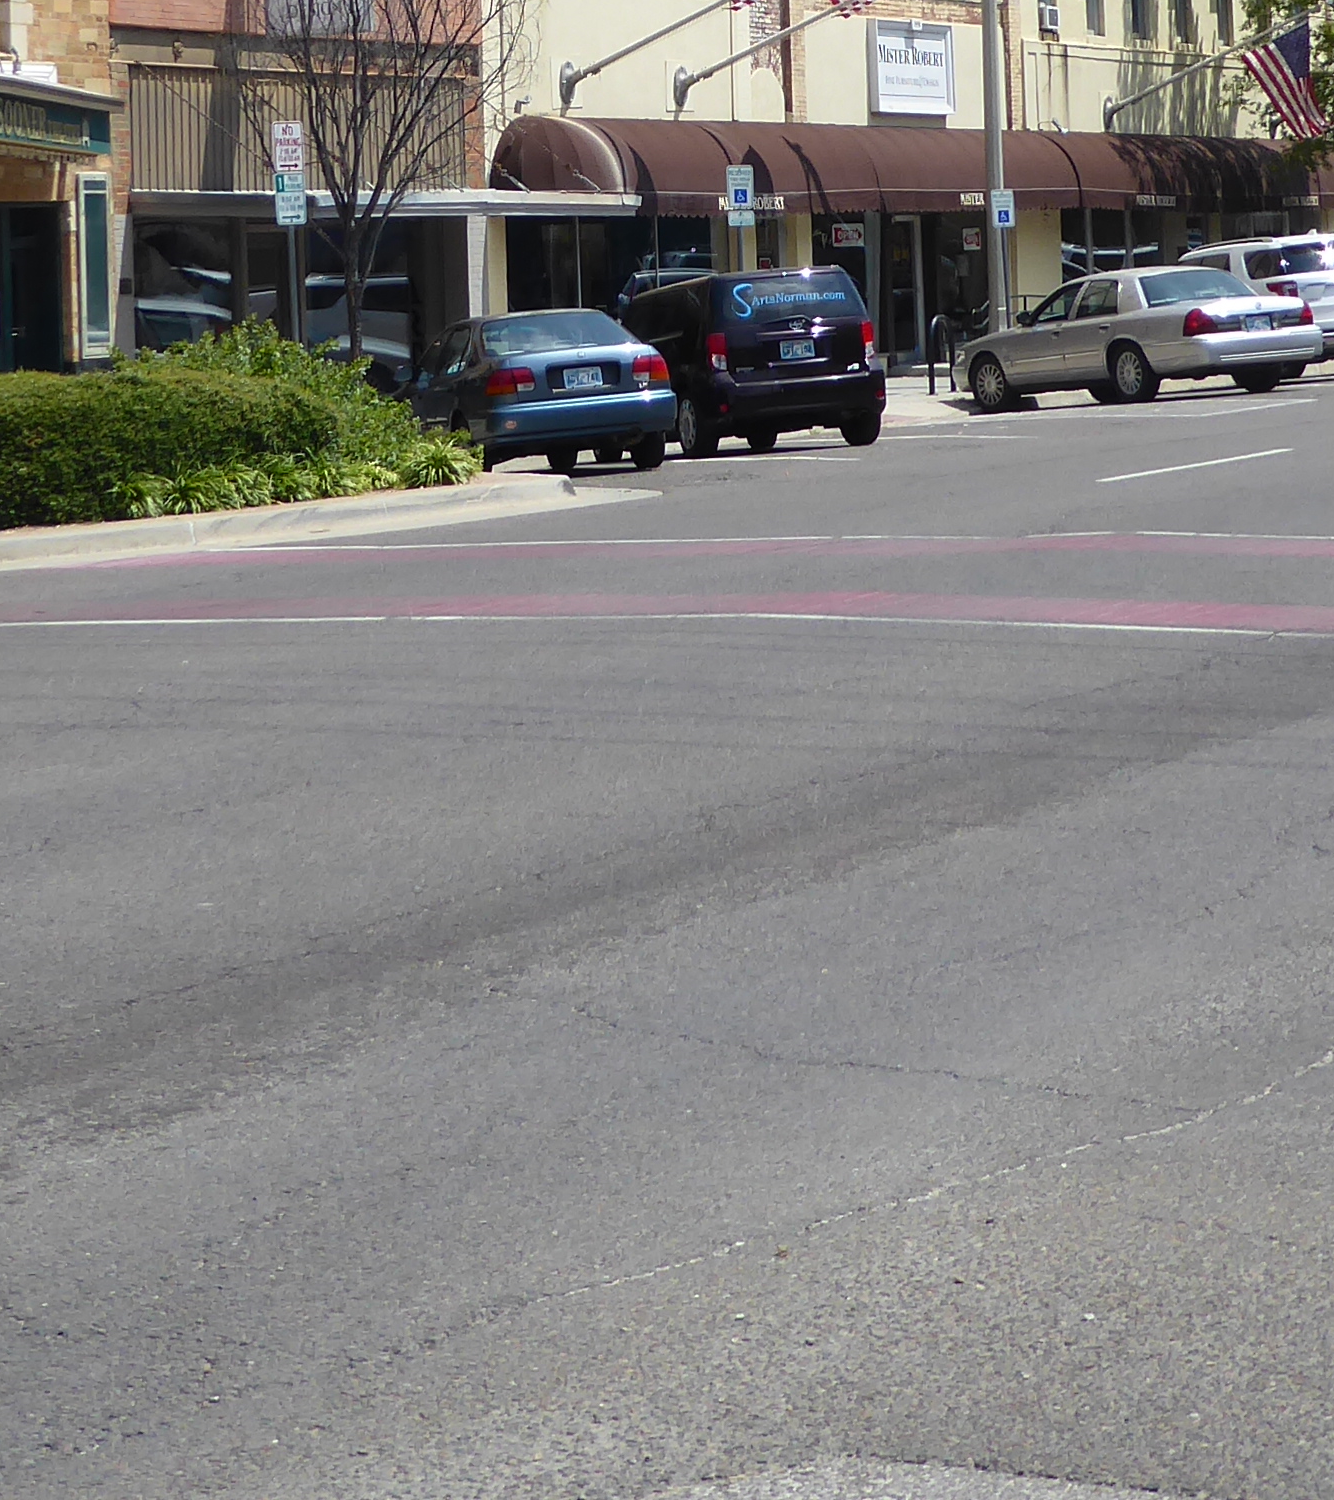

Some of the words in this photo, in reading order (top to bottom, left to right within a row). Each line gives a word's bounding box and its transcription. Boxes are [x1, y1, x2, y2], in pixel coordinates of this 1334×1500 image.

[878, 44, 910, 65] MISTER
[911, 46, 944, 67] ROBERT
[281, 125, 294, 136] NO
